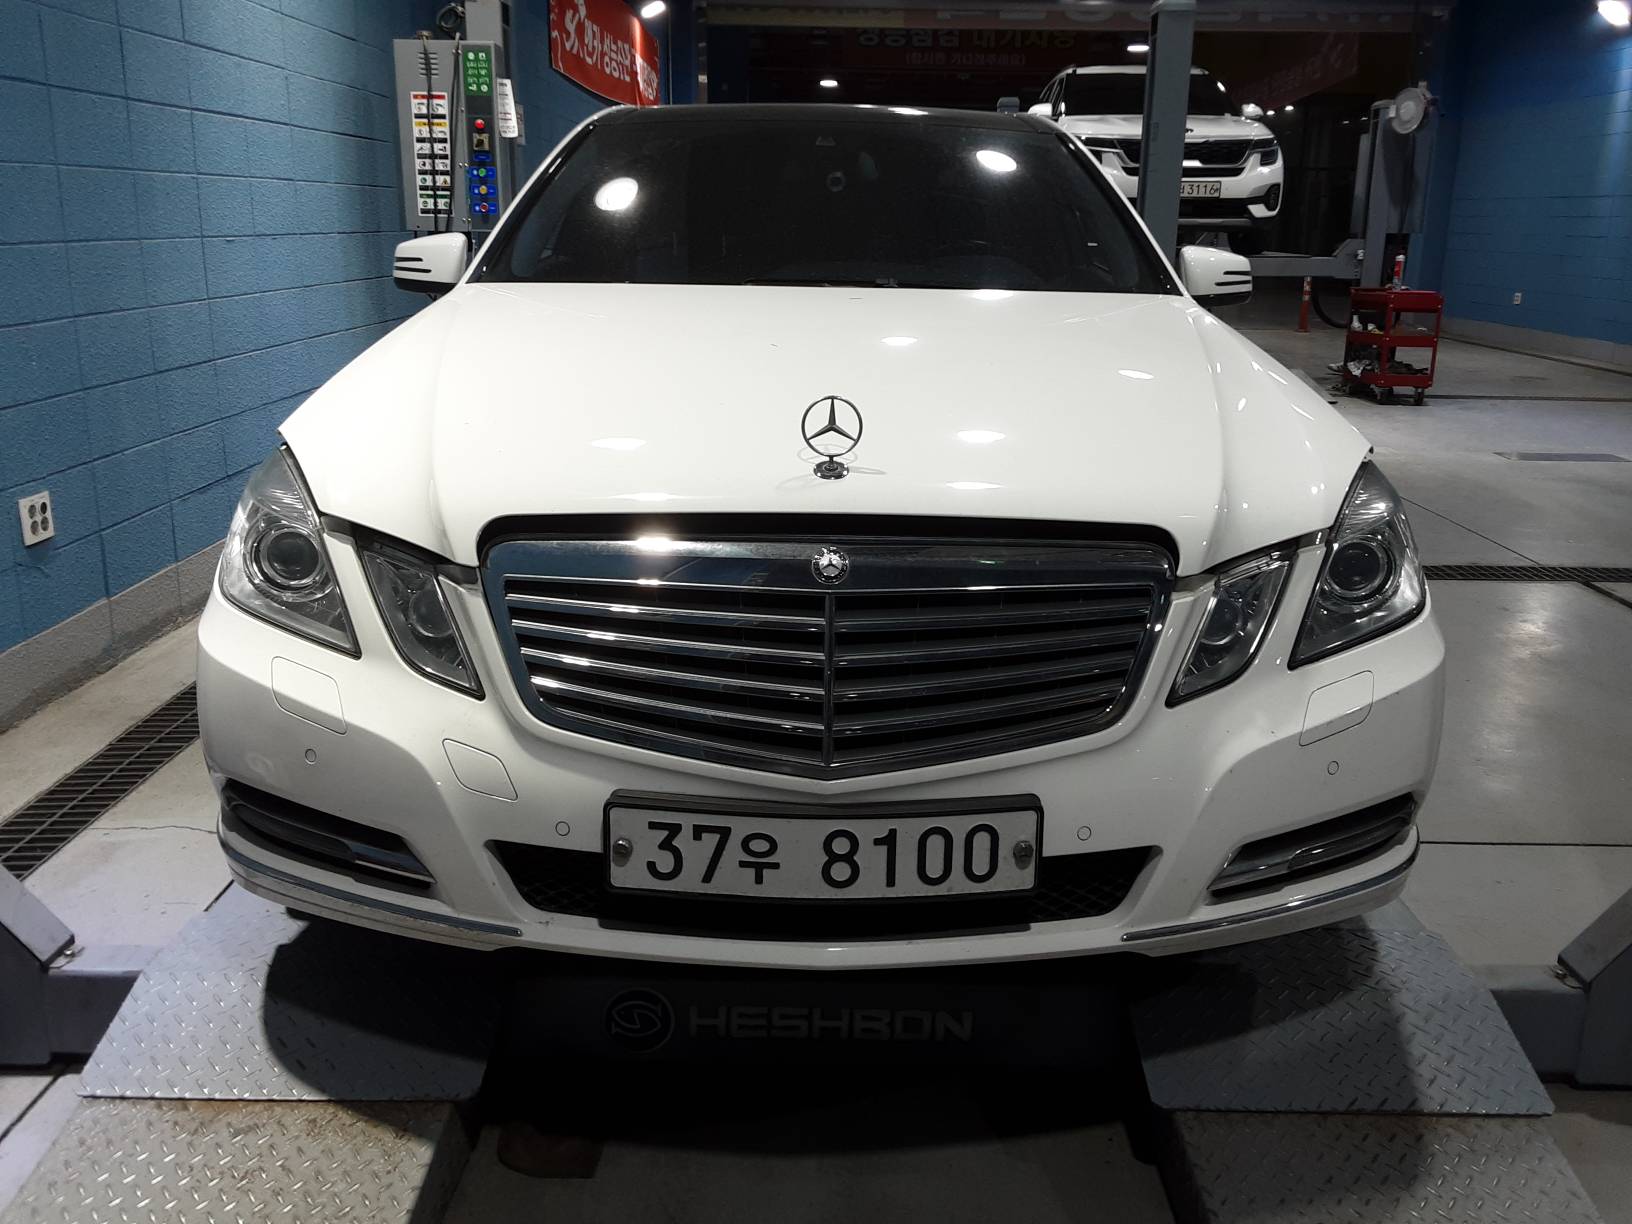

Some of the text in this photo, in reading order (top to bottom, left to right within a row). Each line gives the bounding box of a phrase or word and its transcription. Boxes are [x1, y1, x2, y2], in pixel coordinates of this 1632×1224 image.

[1187, 184, 1215, 195] 3116
[646, 821, 1000, 889] 37우 8100
[688, 1005, 975, 1042] HESHBON
